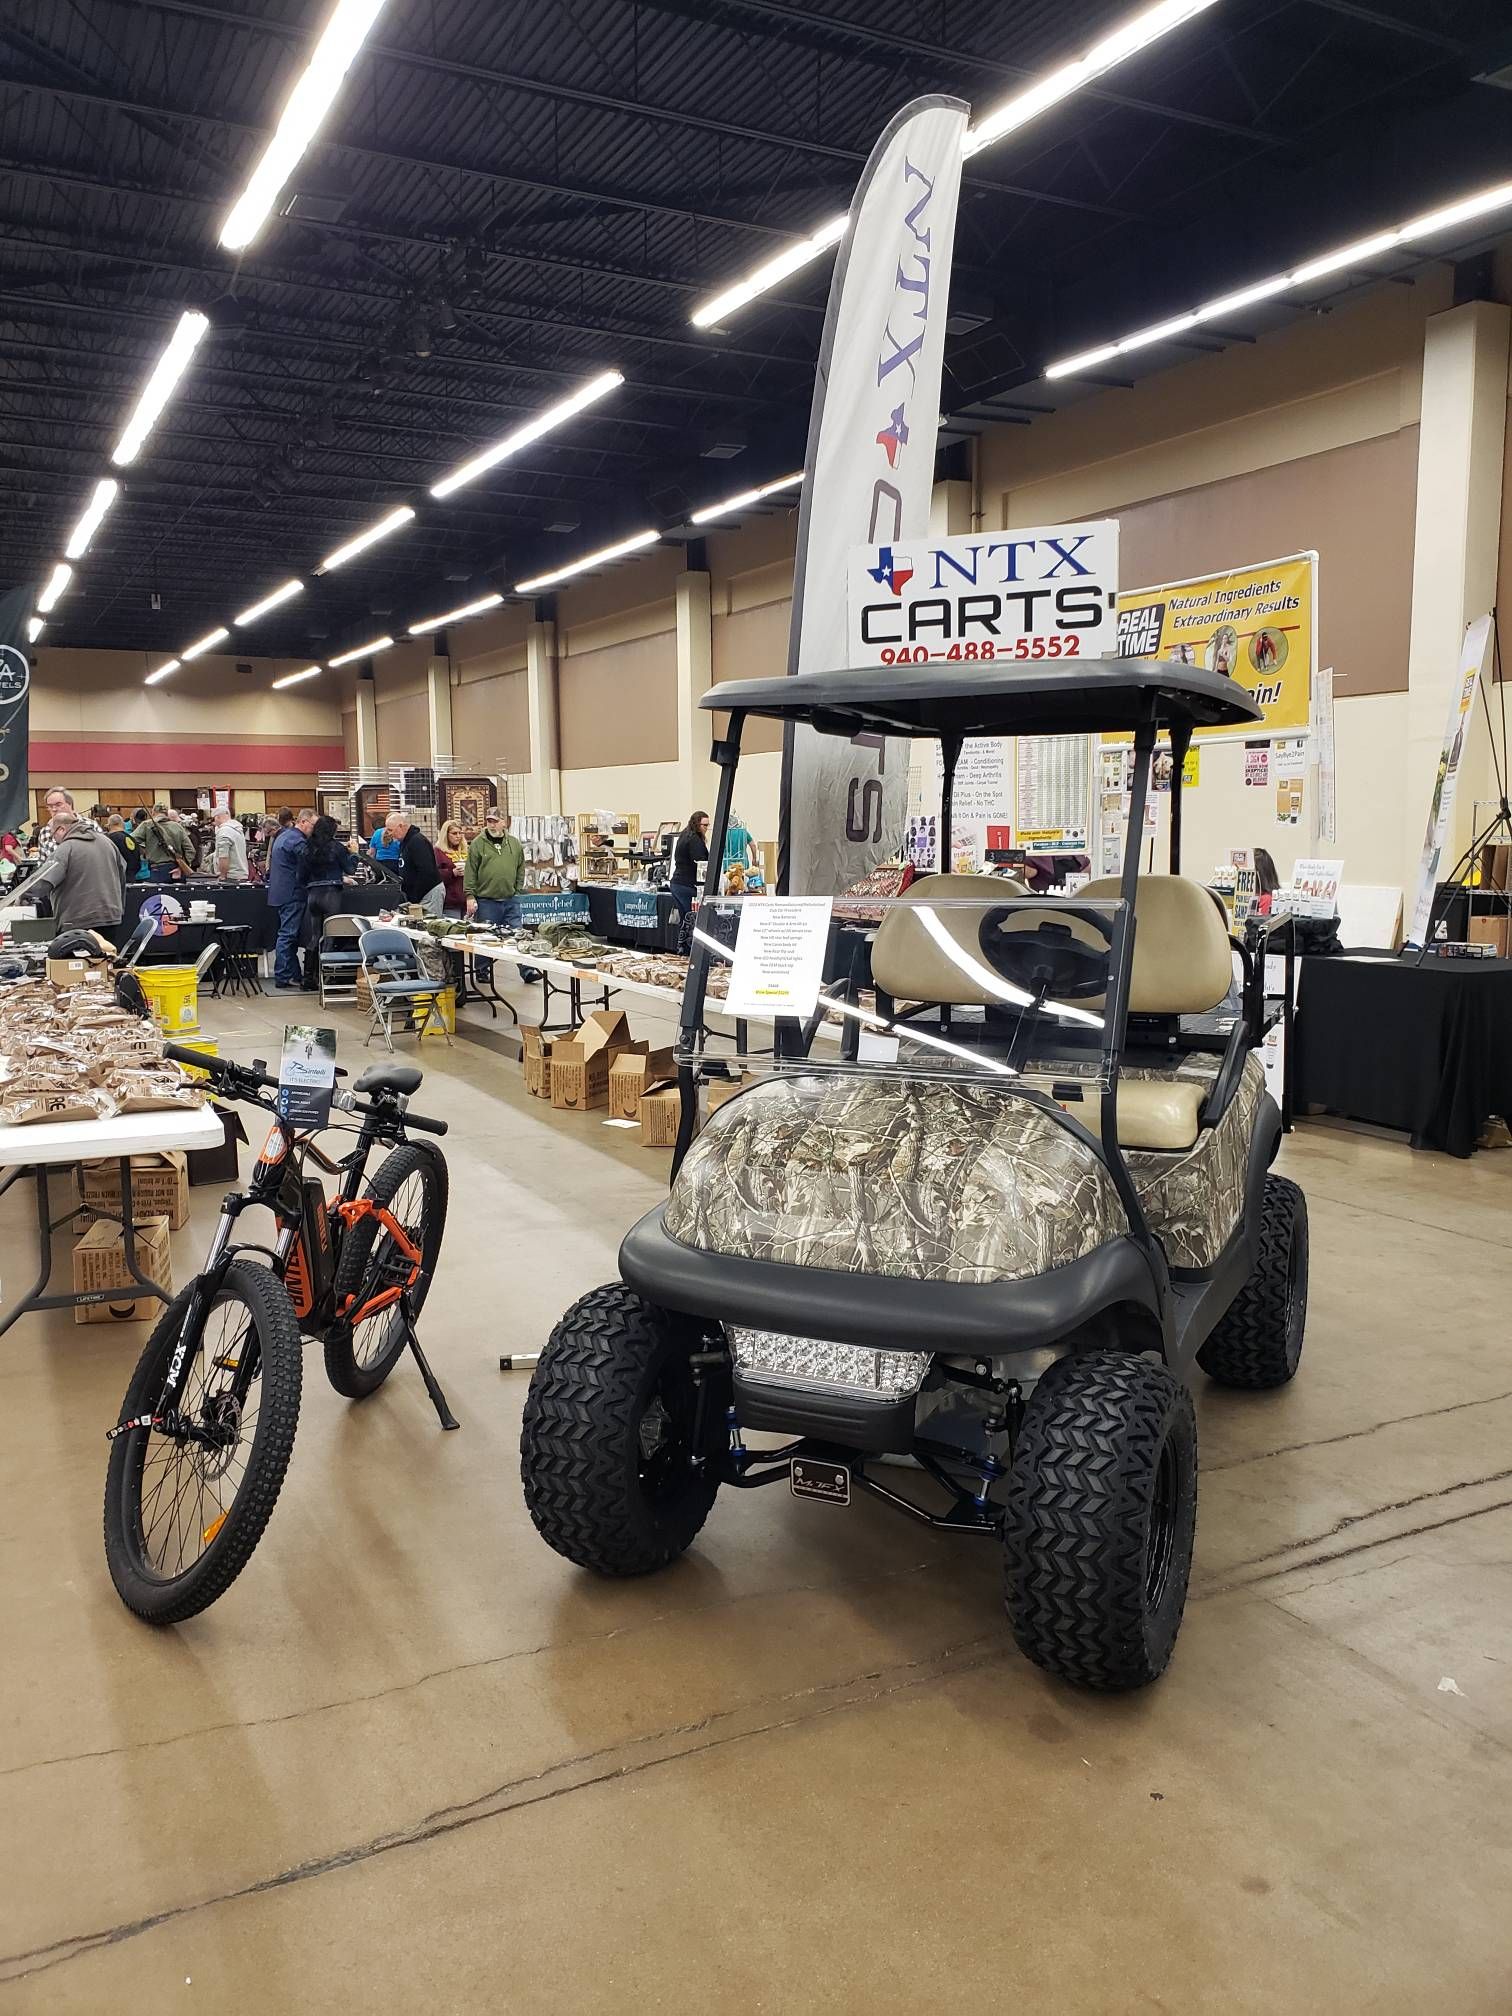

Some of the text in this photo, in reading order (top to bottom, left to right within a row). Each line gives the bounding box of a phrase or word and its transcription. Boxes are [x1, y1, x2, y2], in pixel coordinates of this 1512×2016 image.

[928, 535, 1097, 590] NTX
[1168, 579, 1281, 611] Natural Ingredients
[861, 585, 1103, 644] CARTS
[1173, 596, 1300, 629] Extraordinary Results
[1117, 607, 1160, 657] REAL TIME
[880, 634, 1081, 665] 940-488-5552
[1236, 871, 1255, 893] FREE
